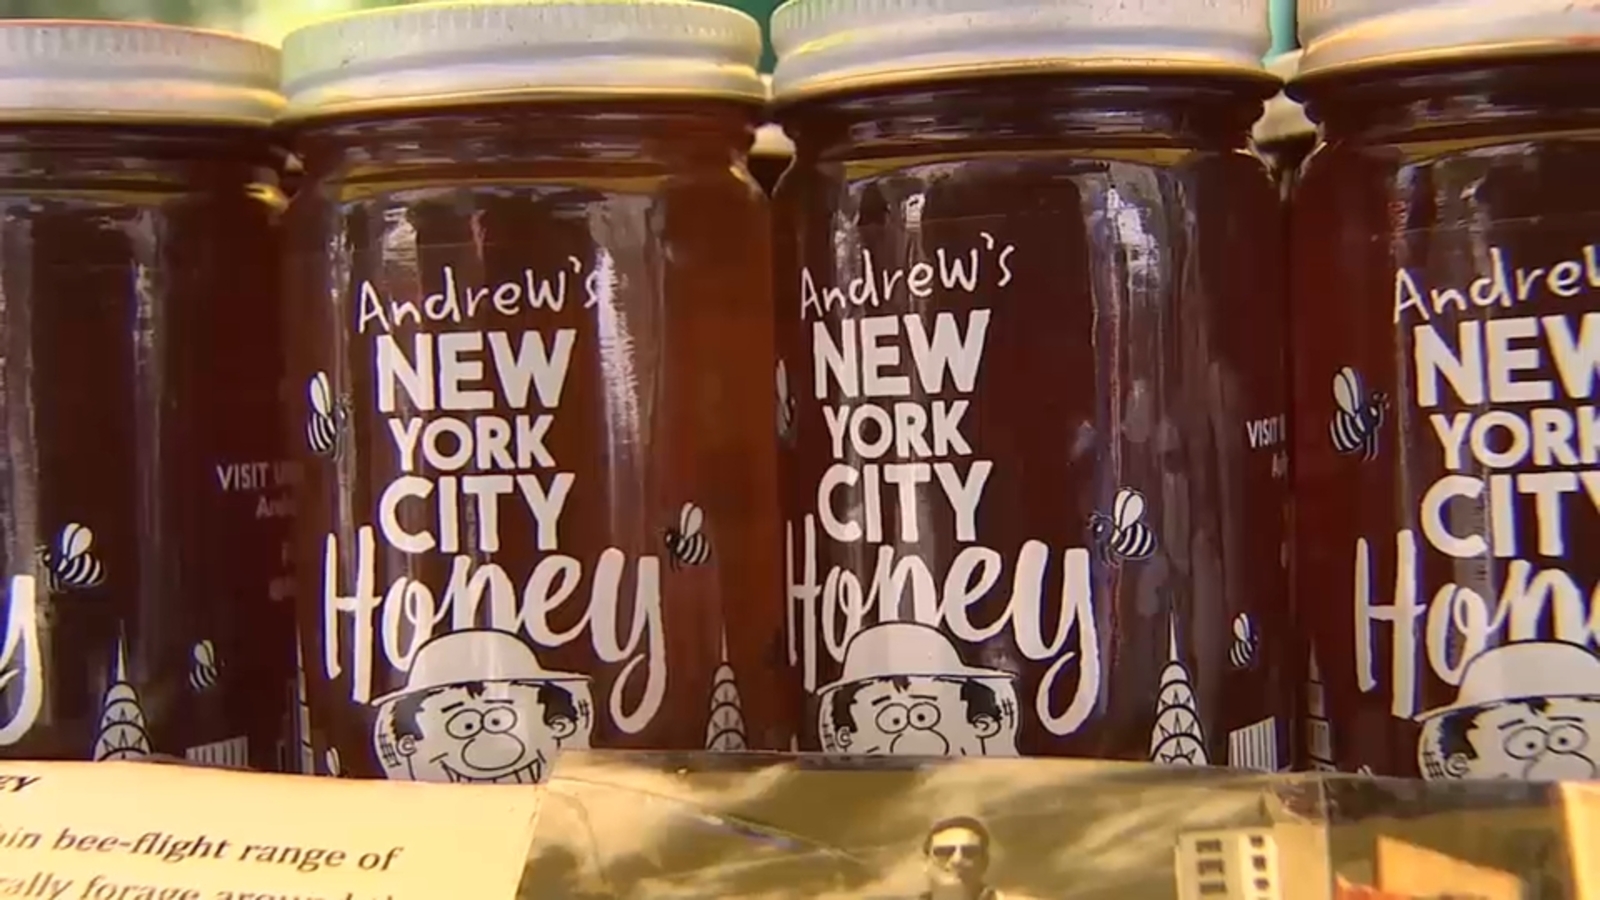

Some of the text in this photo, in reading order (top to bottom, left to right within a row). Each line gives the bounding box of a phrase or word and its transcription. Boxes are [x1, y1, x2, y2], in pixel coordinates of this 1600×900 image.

[374, 328, 577, 413] NEW
[812, 308, 991, 399] NEW
[388, 414, 556, 472] YORK
[822, 400, 973, 459] YORK
[1246, 416, 1278, 448] VISIT
[216, 461, 269, 491] VISIT
[379, 472, 576, 554] CITY
[817, 460, 993, 543] CITY
[325, 526, 667, 734] Honey
[786, 513, 1101, 736] Honey
[1354, 529, 1600, 720] Hon
[52, 827, 232, 863] bee-flight
[238, 844, 347, 873] range
[357, 846, 404, 871] of
